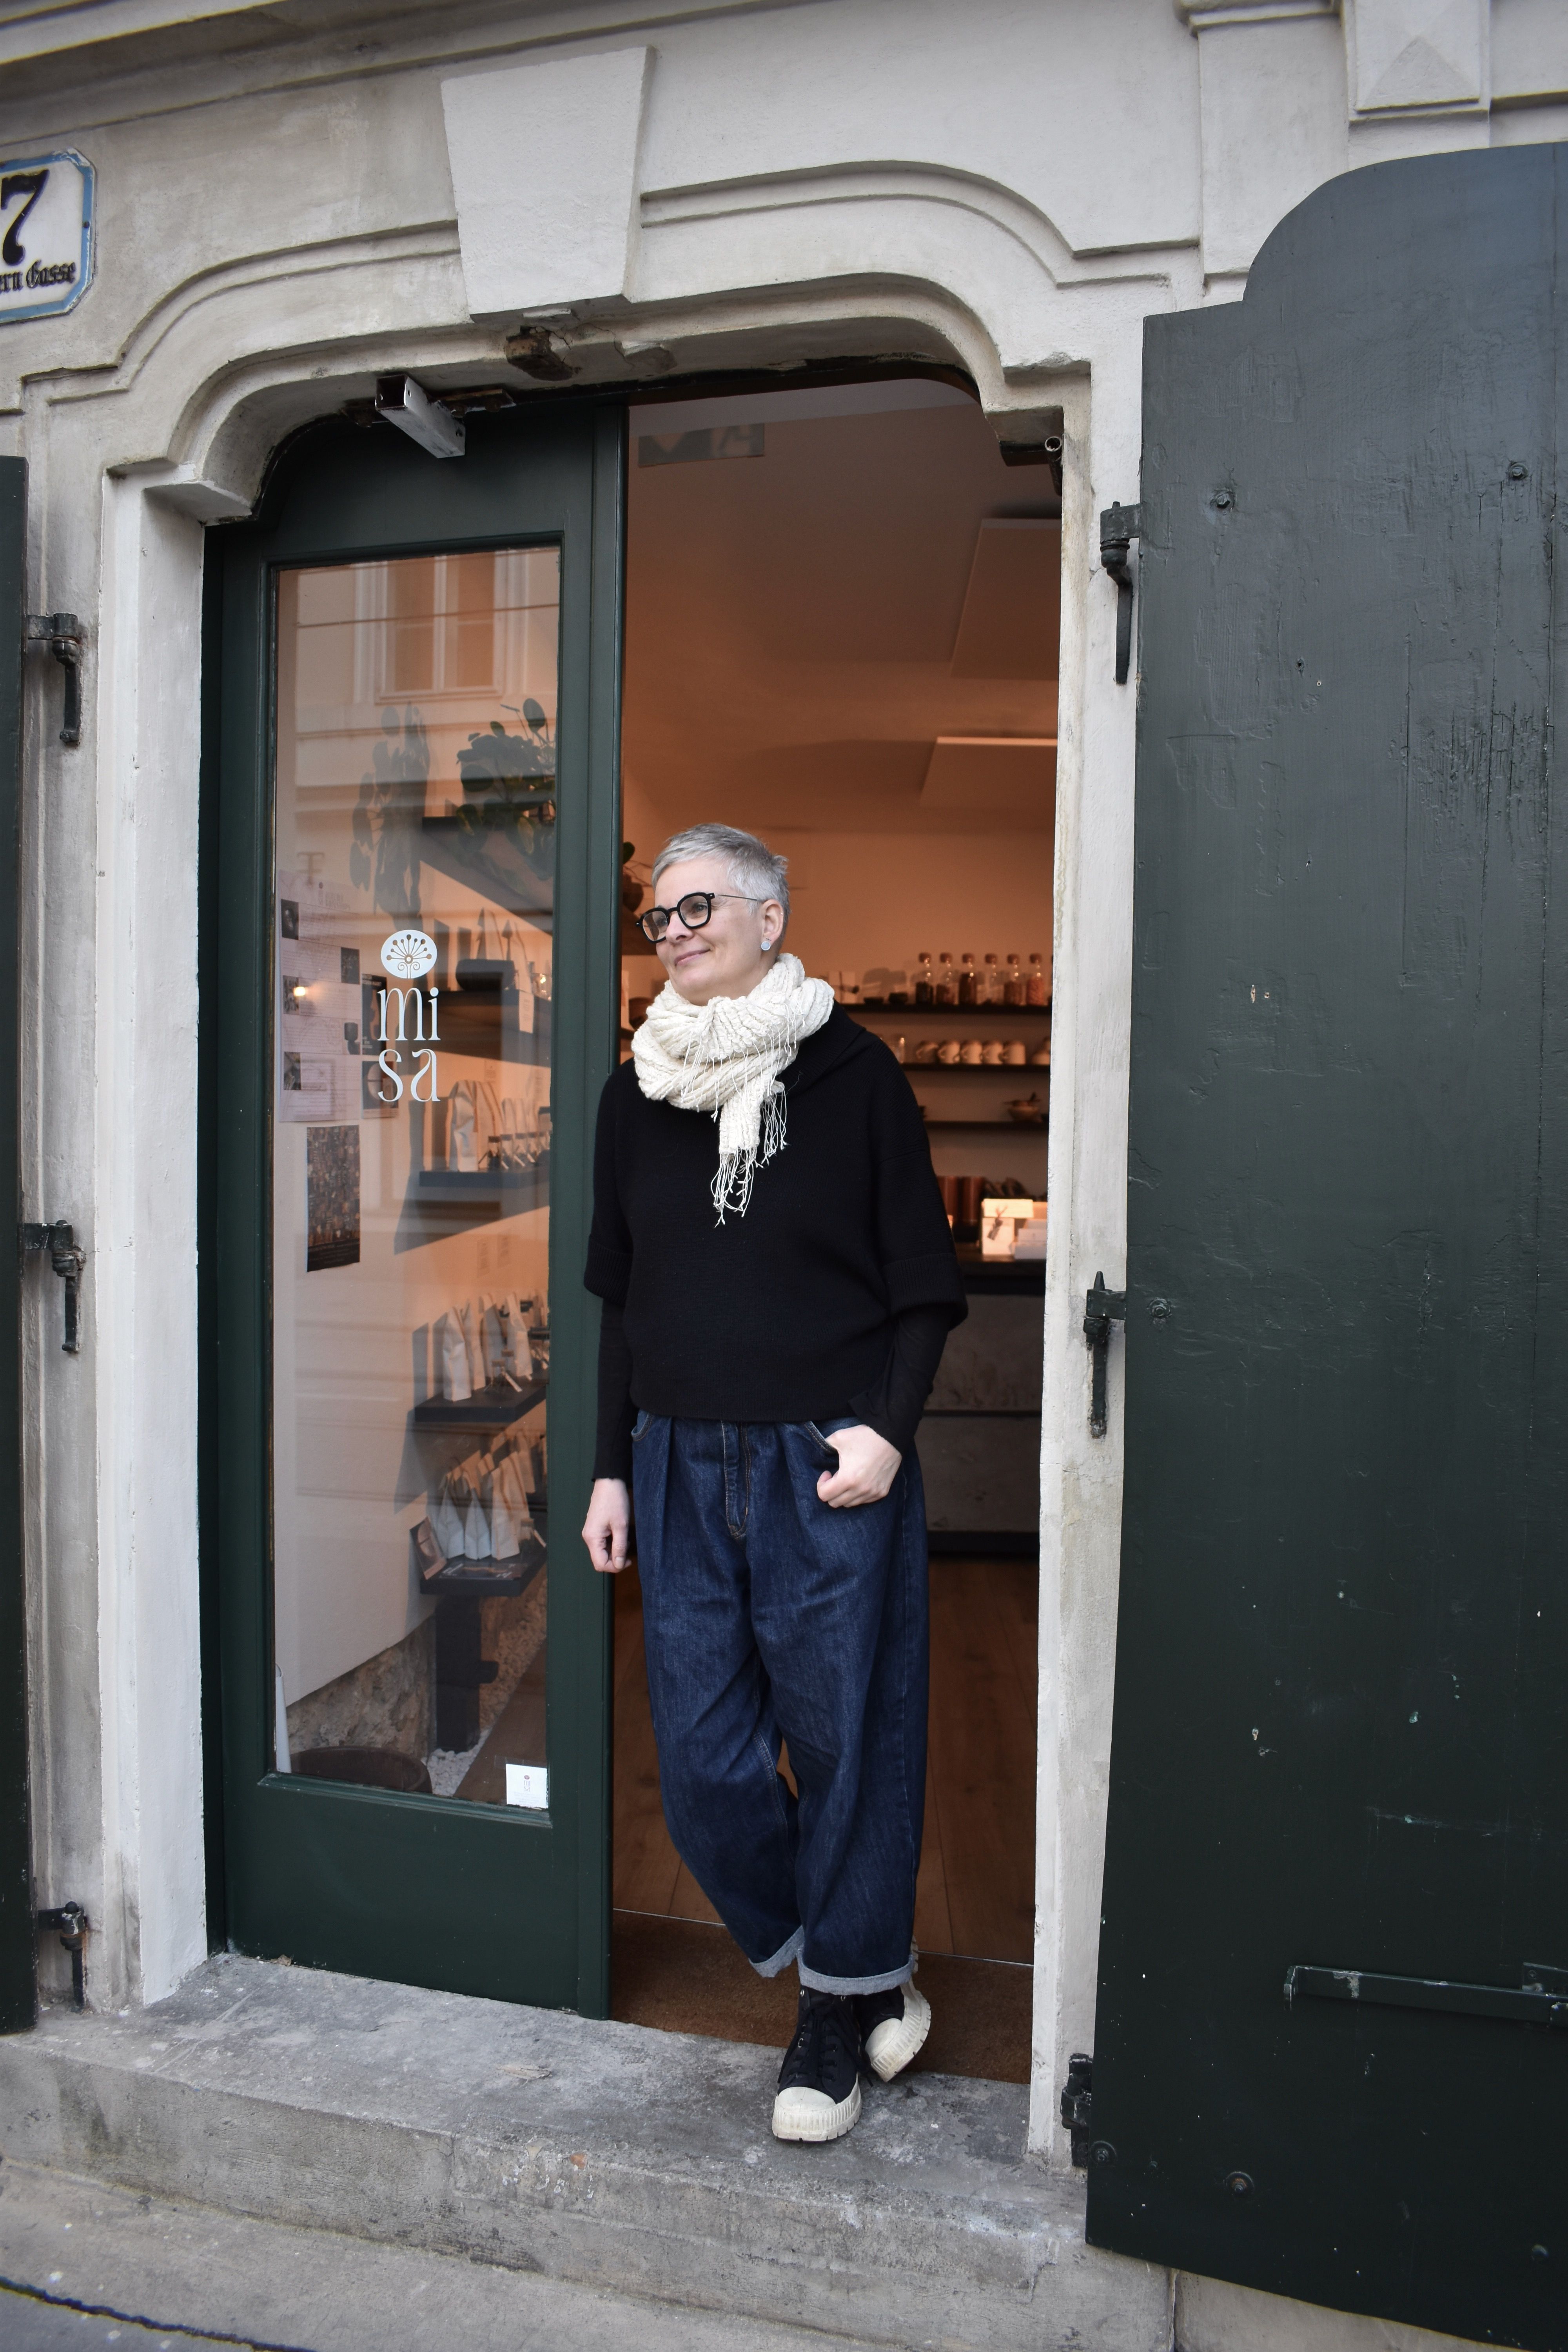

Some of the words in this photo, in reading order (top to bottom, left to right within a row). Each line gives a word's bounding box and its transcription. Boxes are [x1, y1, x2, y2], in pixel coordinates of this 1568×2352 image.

[1, 169, 50, 266] 7
[26, 259, 76, 288] Gasse
[377, 987, 441, 1041] mi
[378, 1049, 441, 1102] sa
